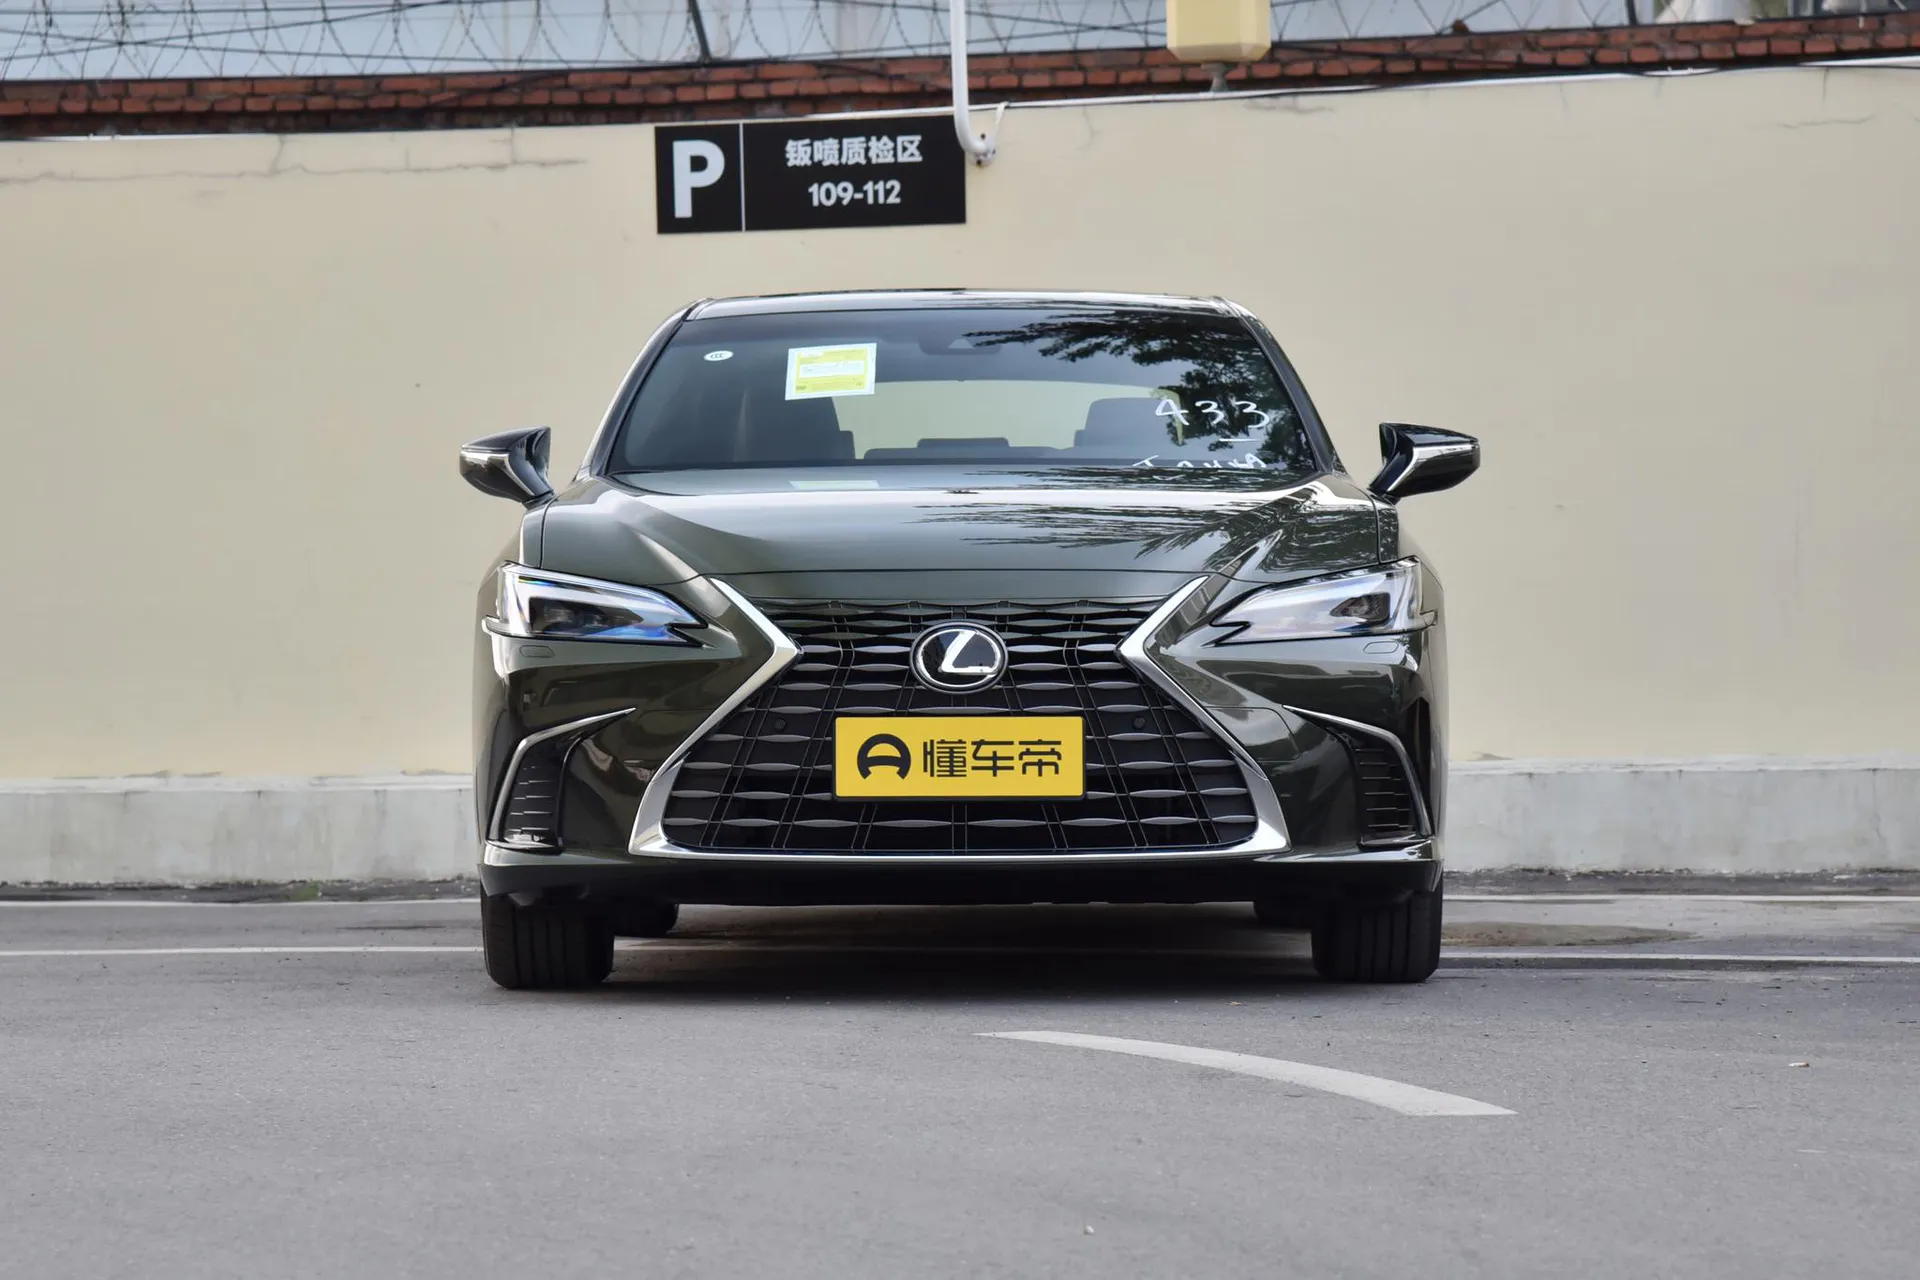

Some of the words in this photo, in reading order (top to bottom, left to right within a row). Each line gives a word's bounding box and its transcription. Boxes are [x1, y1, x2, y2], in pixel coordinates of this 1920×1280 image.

[785, 135, 923, 167] 钣喷质检区
[673, 139, 725, 219] P
[808, 180, 901, 207] 109-112
[1155, 398, 1270, 428] 433
[923, 739, 1062, 777] 懂车帝
